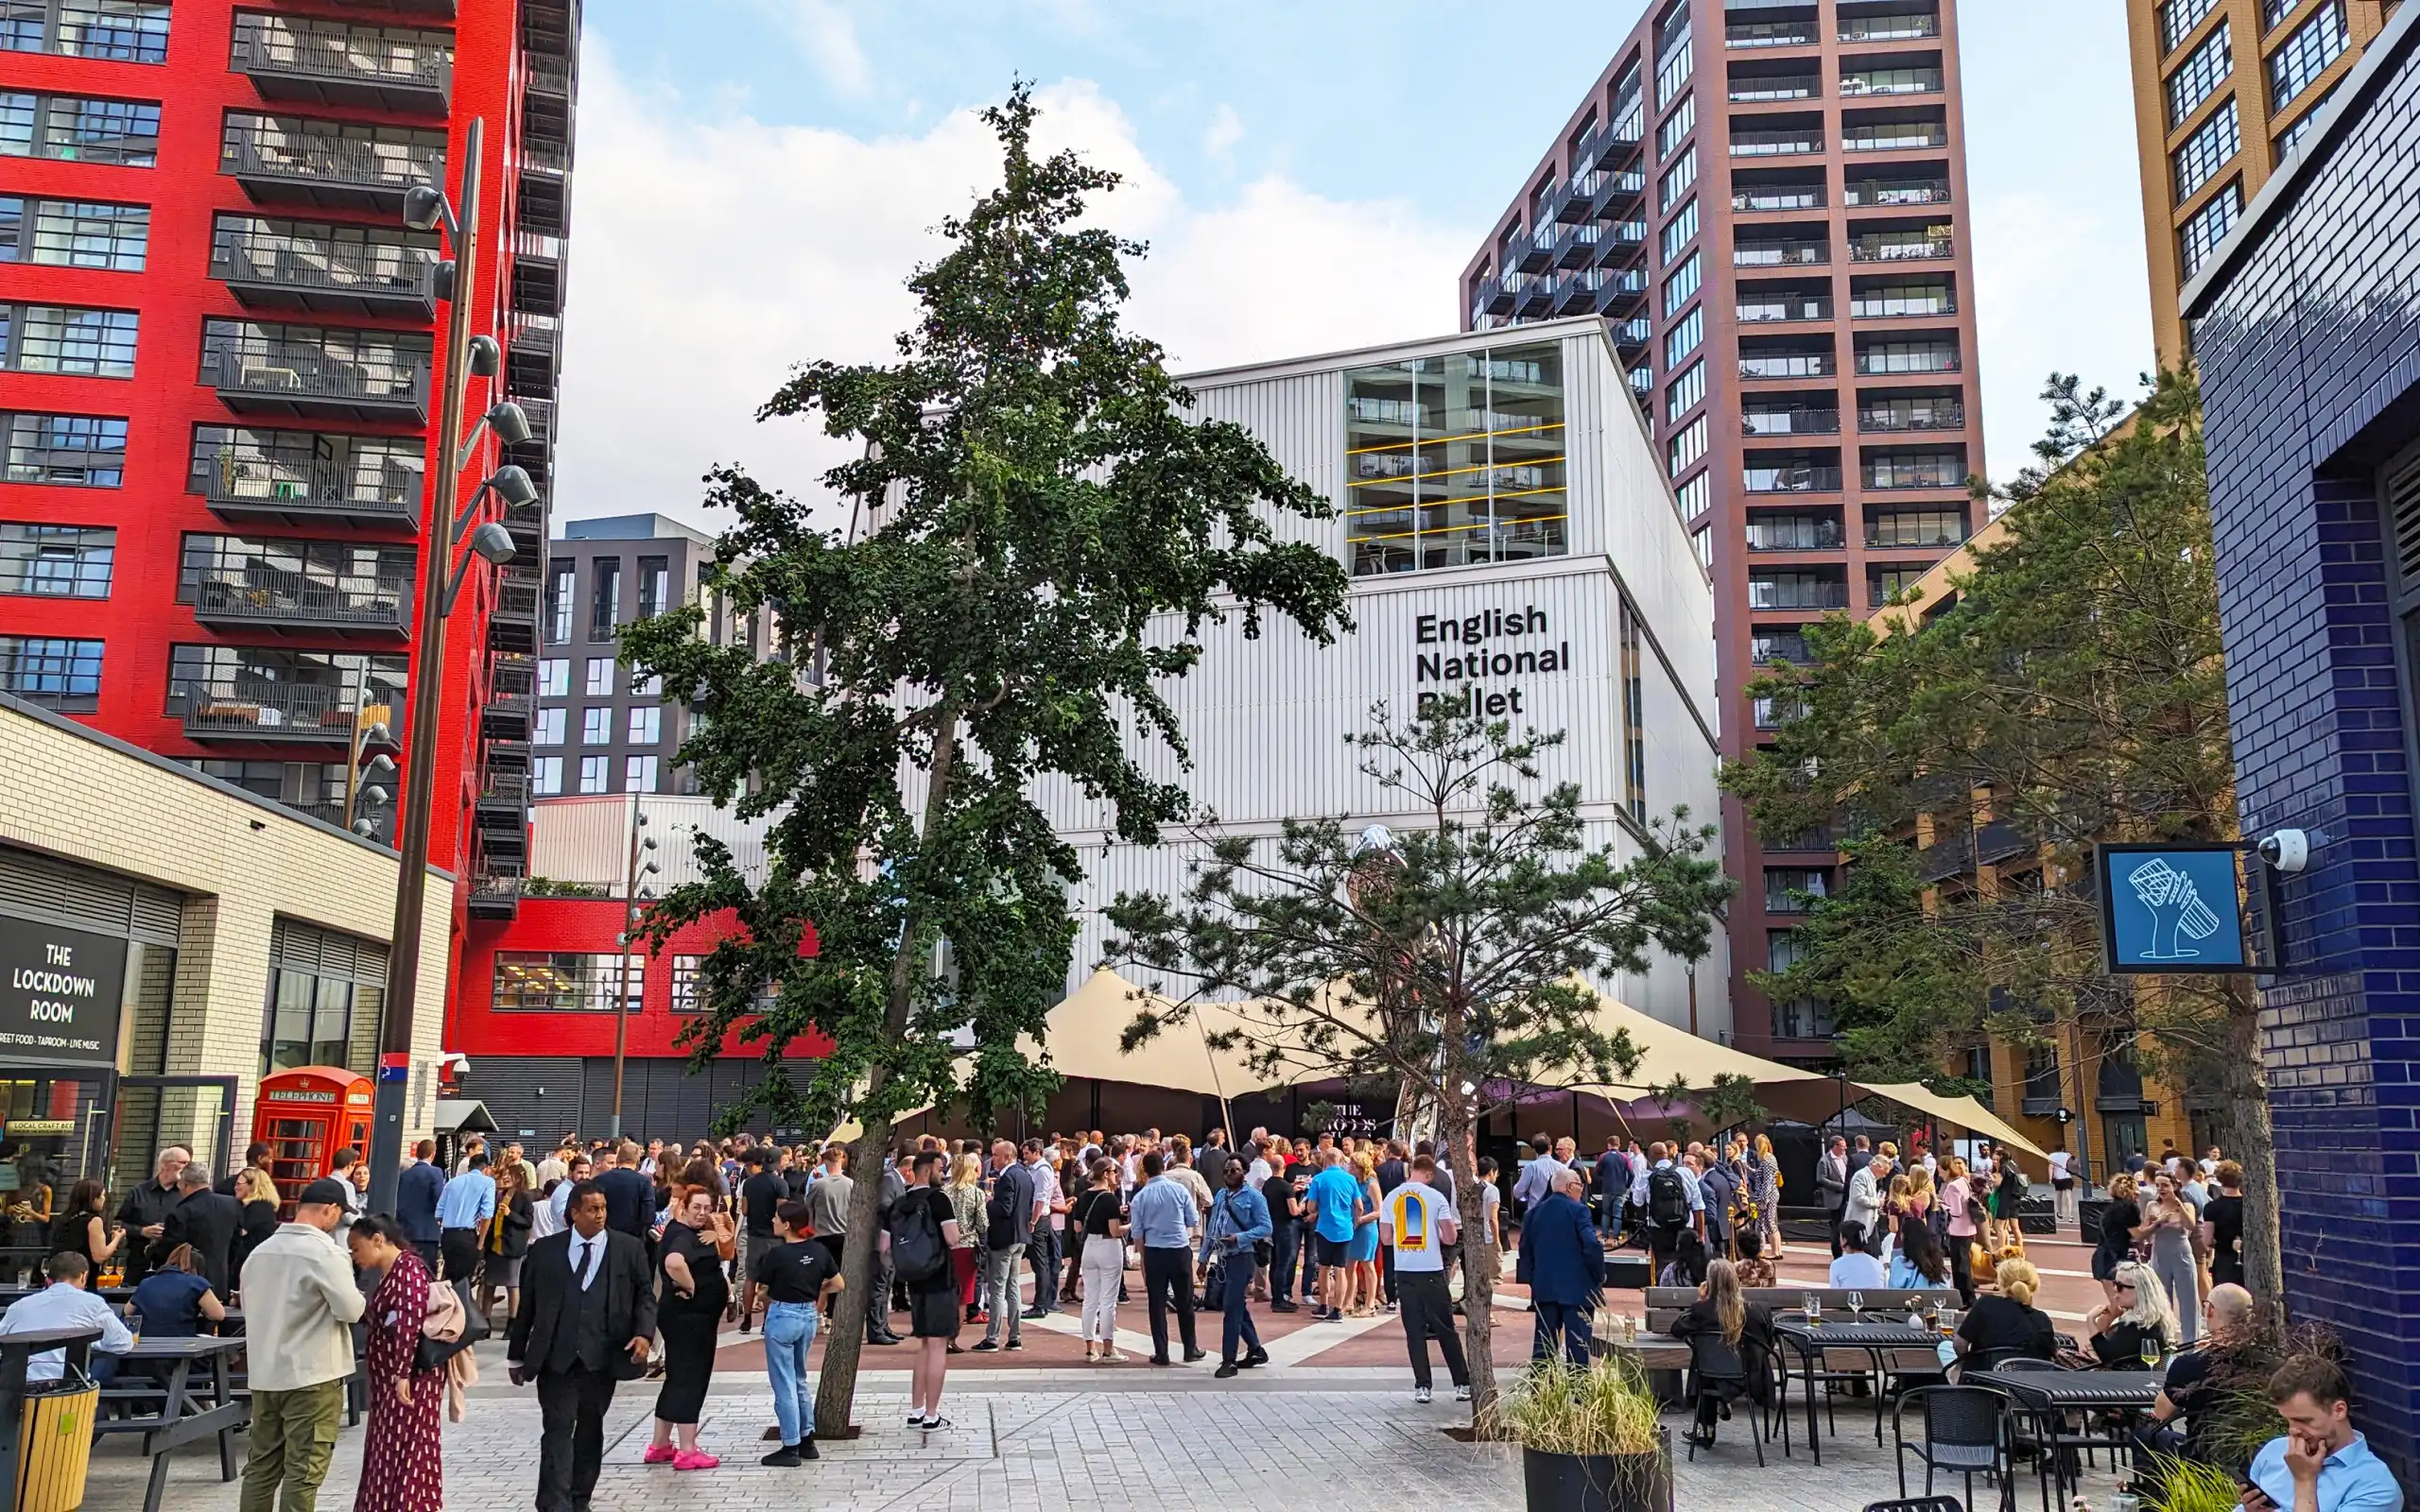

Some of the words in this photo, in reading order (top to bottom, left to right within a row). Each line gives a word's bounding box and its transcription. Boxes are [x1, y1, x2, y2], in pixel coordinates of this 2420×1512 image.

[1417, 606, 1547, 644] English
[1417, 642, 1568, 682] National
[1417, 687, 1523, 721] Bllet
[46, 944, 72, 967] THE
[13, 968, 95, 997] LOCKDOWN
[30, 1000, 74, 1023] ROOM
[15, 1034, 34, 1045] FOOD
[38, 1036, 67, 1048] TAPROOM
[70, 1039, 82, 1049] LIVE
[82, 1040, 100, 1051] MUSIC
[271, 1091, 334, 1102] TELEPHONE
[1334, 1105, 1362, 1116] THE
